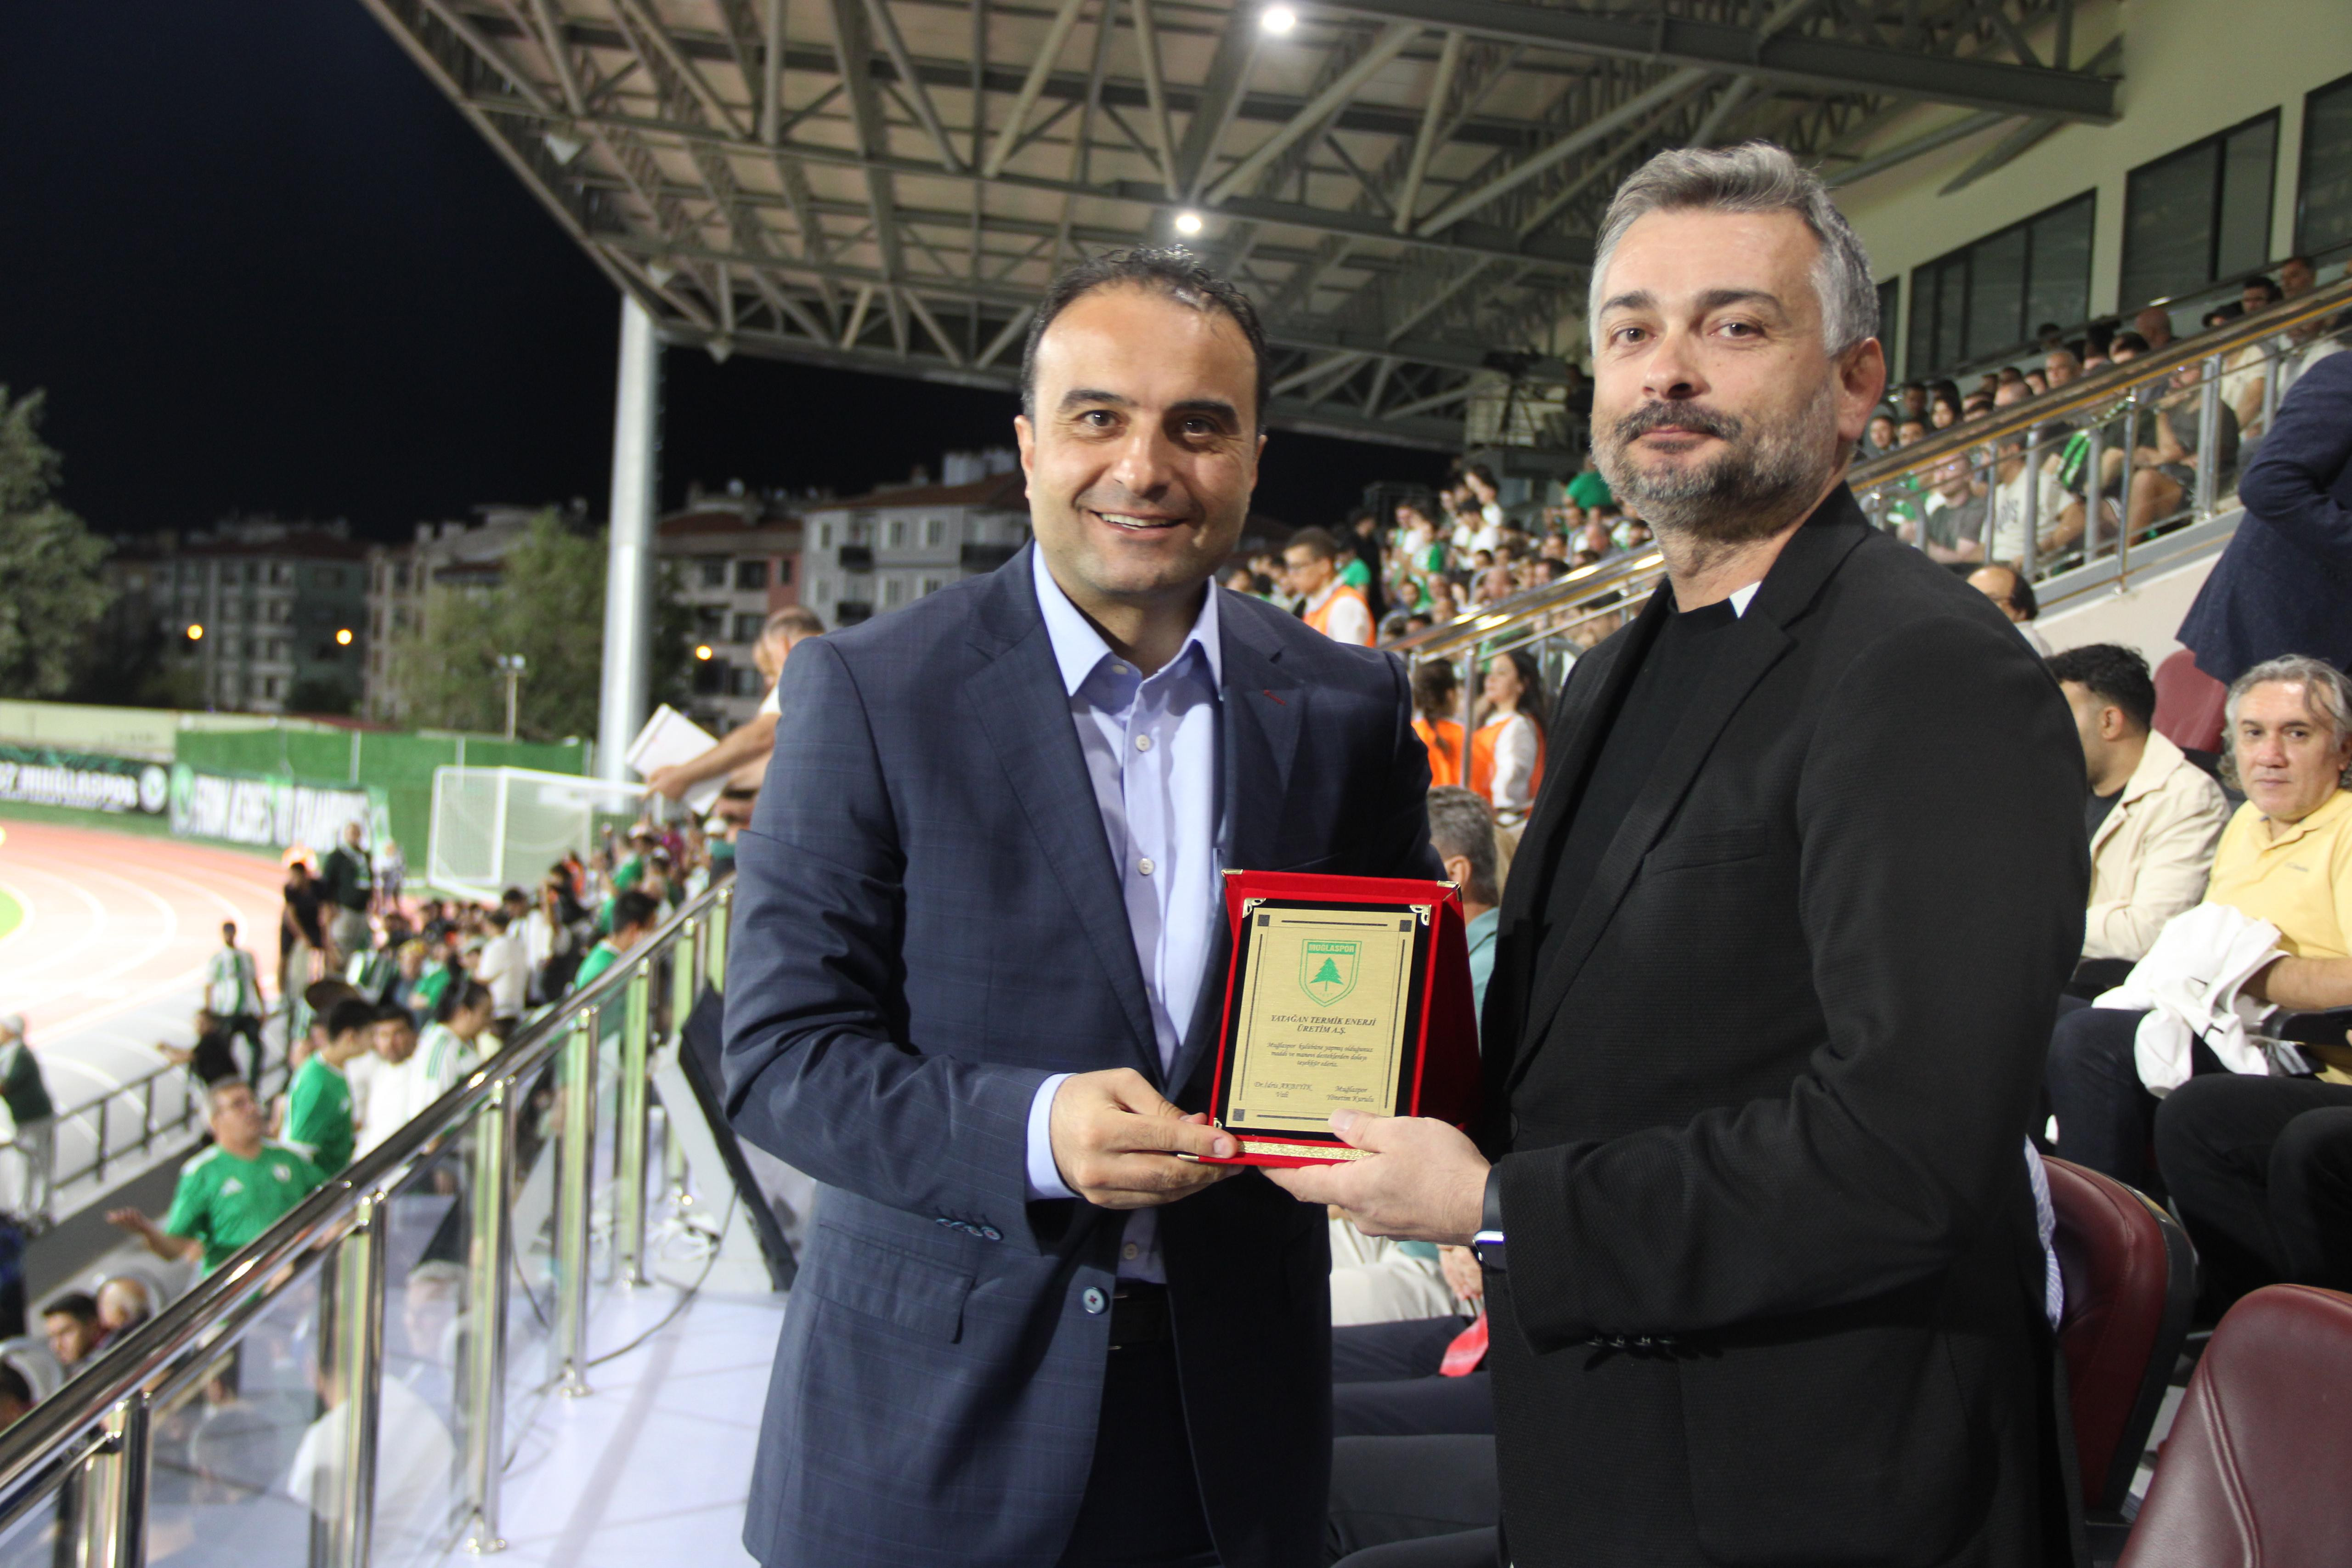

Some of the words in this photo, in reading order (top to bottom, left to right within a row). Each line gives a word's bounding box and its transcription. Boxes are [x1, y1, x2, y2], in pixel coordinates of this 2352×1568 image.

[1308, 944, 1355, 952] MUĞLASPOR
[1271, 1014, 1309, 1023] YATAĞAN
[1310, 1016, 1343, 1025] TERMİK
[1345, 1018, 1377, 1026] ENERJİ
[1297, 1024, 1330, 1033] ÜRETİM
[1334, 1086, 1368, 1094] Muğlaspor
